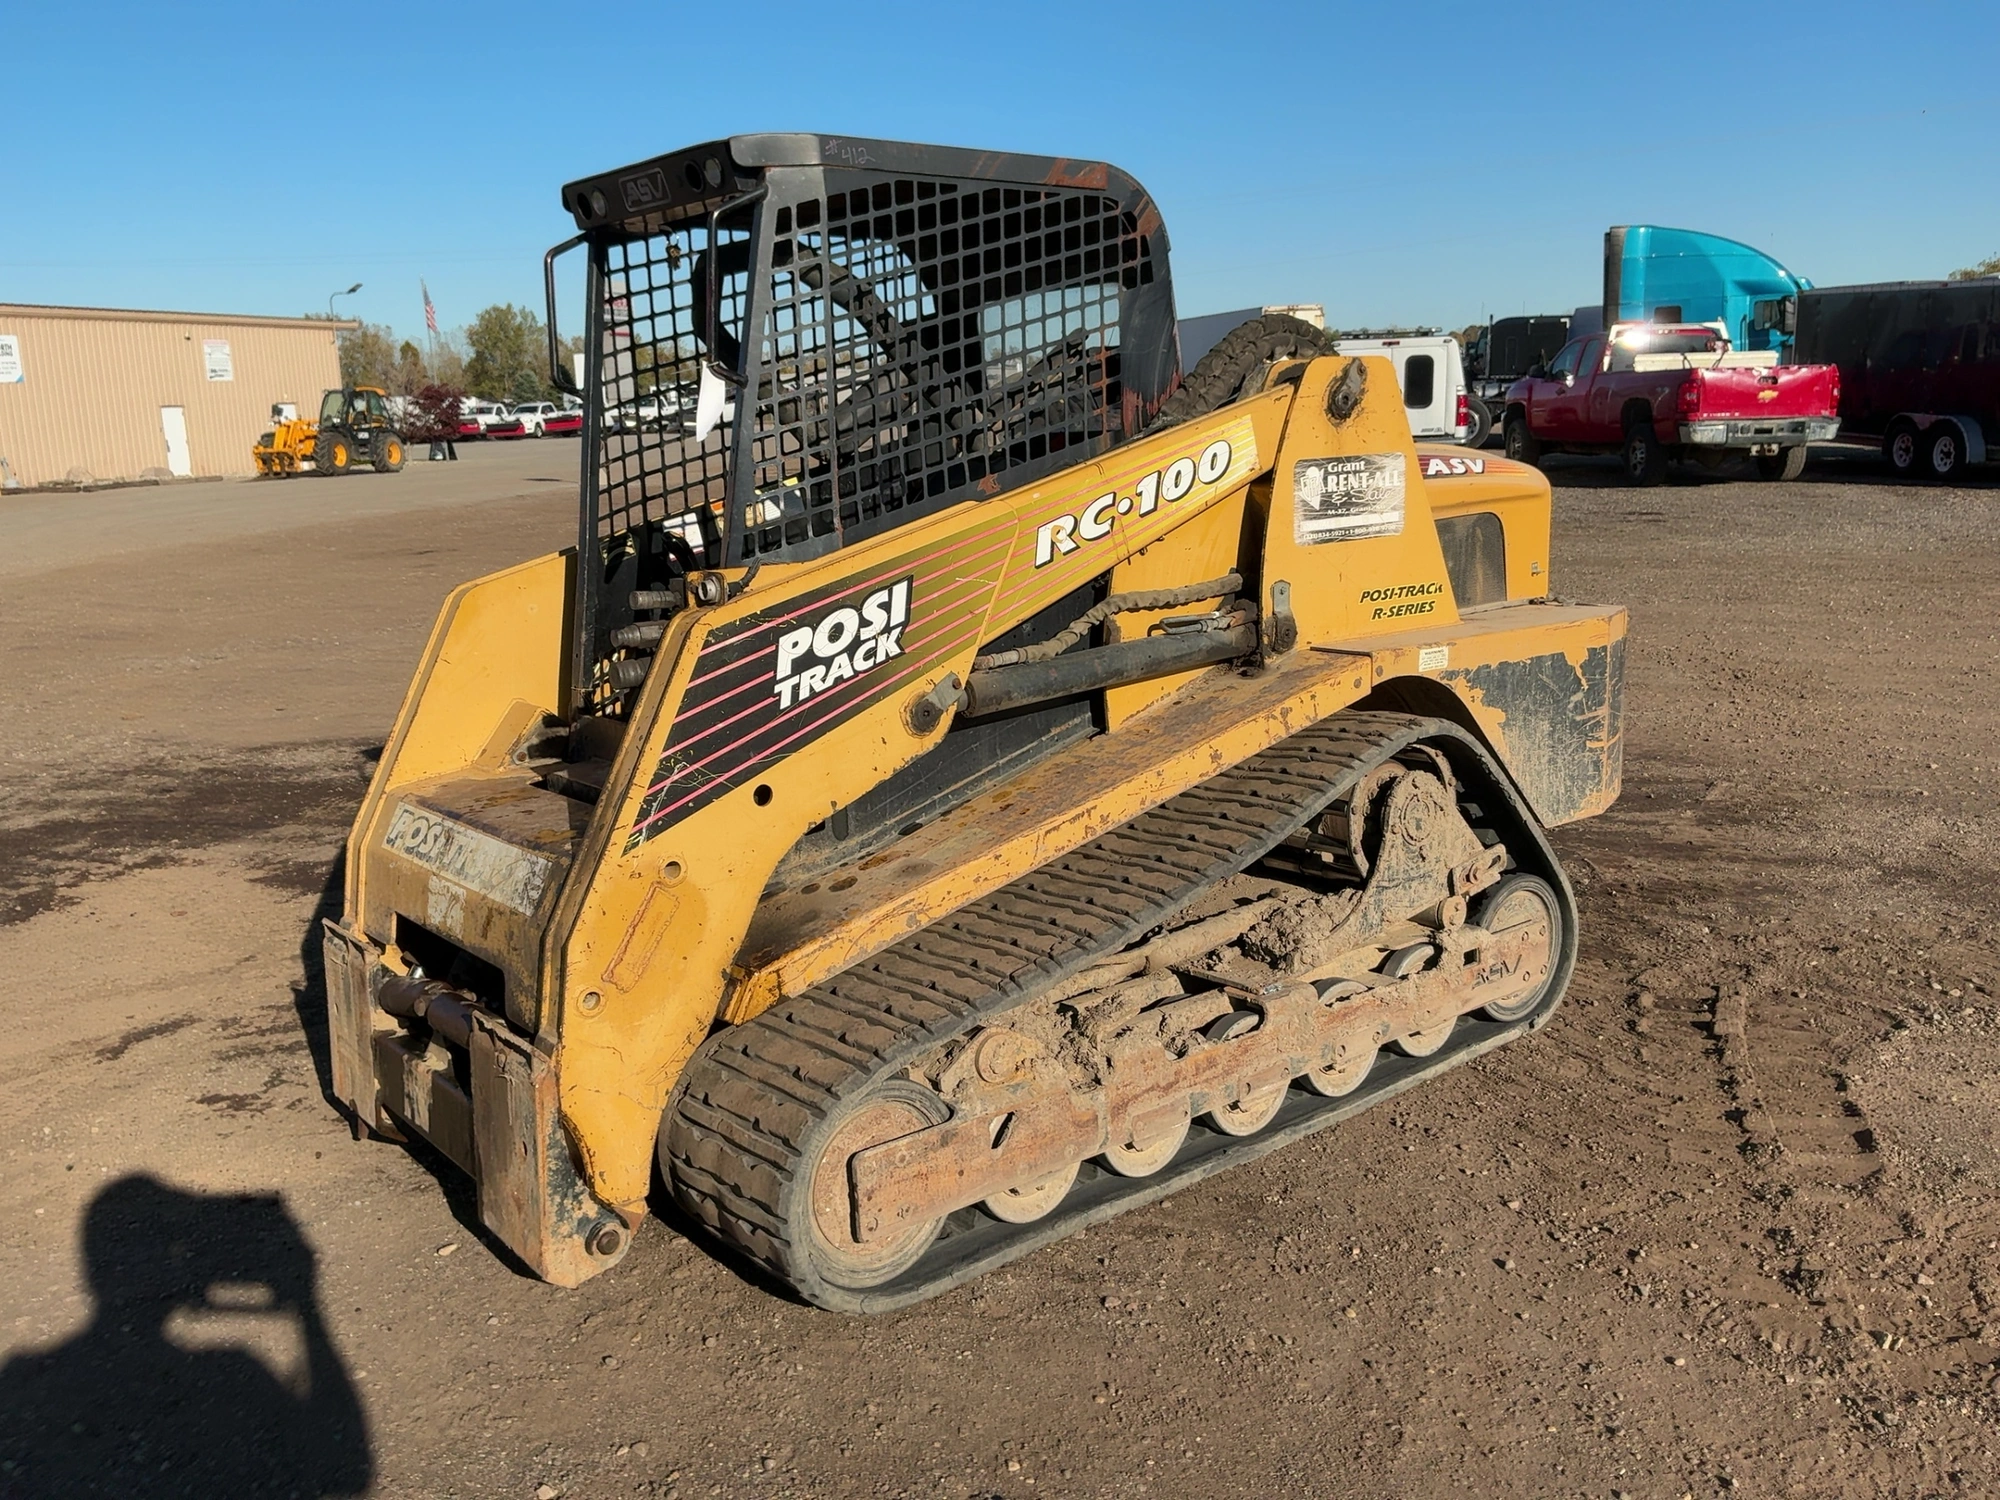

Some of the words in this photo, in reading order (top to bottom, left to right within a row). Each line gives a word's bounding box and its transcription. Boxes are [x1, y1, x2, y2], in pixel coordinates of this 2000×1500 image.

[626, 171, 664, 205] ASV
[1327, 460, 1366, 473] Grant
[1426, 458, 1485, 476] ASV
[1326, 469, 1401, 493] RENT-ALL
[1360, 582, 1443, 603] POSI-TRACK
[1371, 601, 1436, 620] R-SERIES
[775, 579, 909, 681] POSI
[773, 626, 903, 710] TRACK
